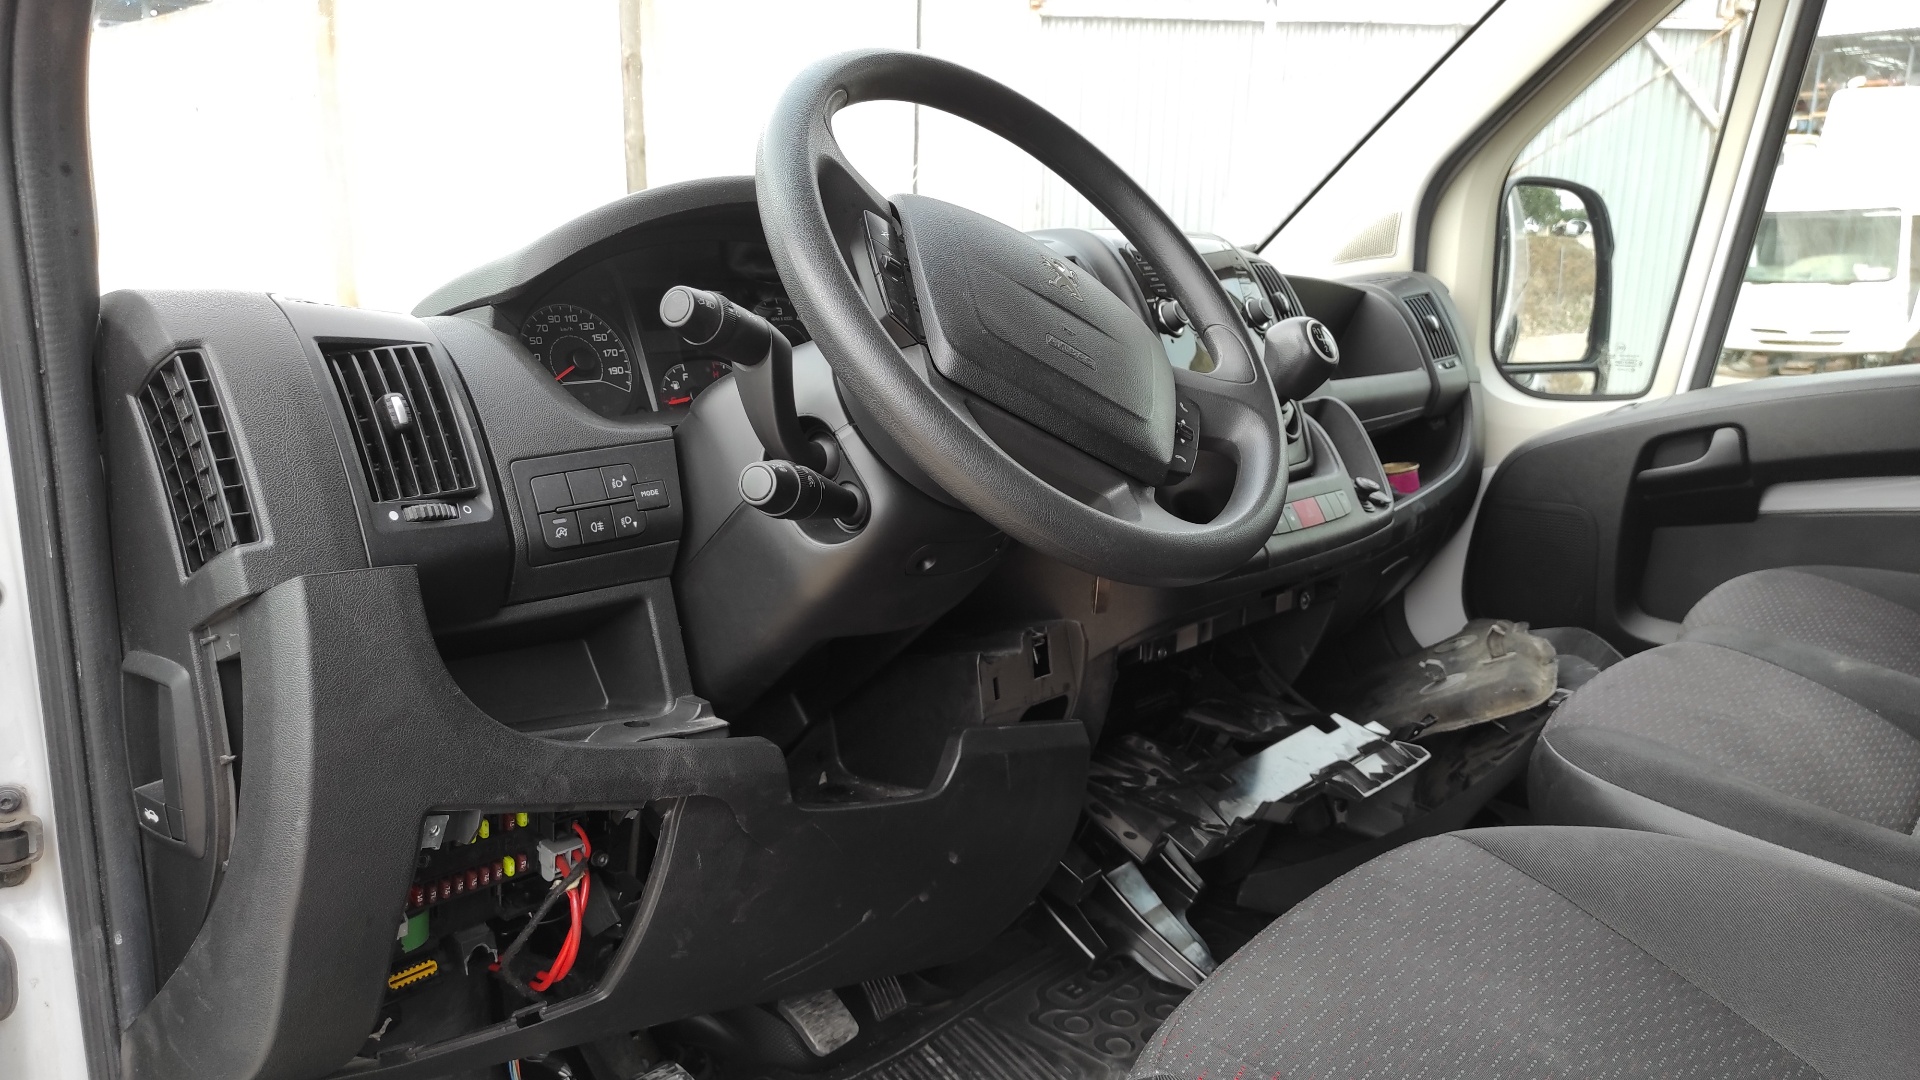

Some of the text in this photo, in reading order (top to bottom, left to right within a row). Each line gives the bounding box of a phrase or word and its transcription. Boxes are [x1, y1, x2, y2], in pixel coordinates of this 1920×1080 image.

[776, 307, 782, 315] 3
[548, 315, 560, 323] 90
[529, 336, 542, 344] 50
[608, 366, 624, 374] 190
[640, 489, 659, 497] MODE
